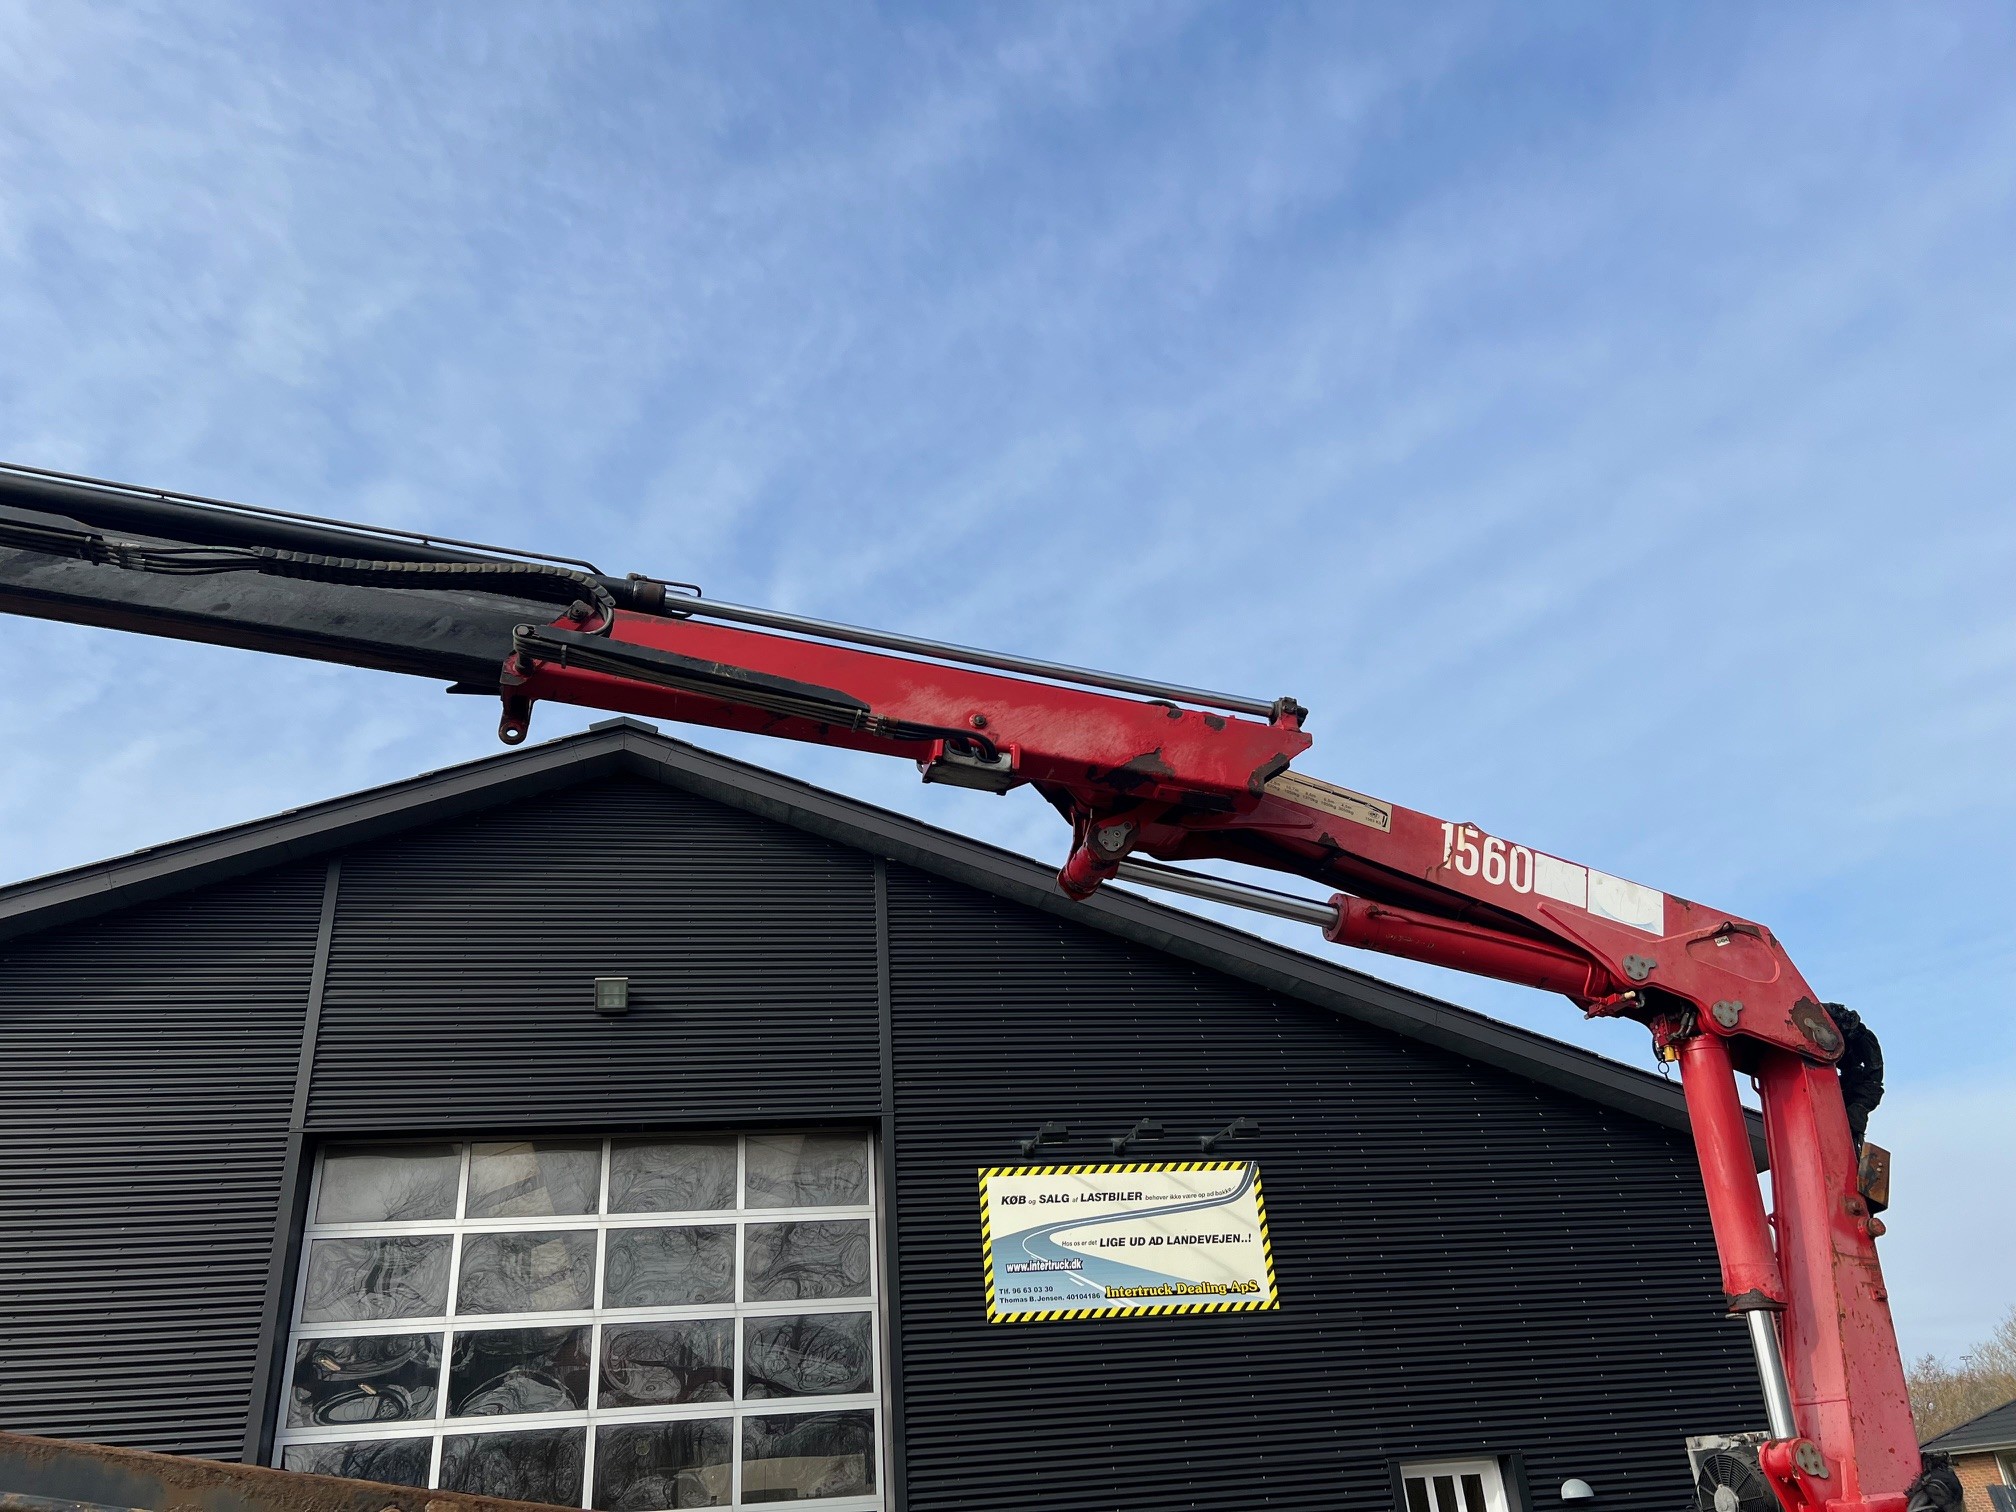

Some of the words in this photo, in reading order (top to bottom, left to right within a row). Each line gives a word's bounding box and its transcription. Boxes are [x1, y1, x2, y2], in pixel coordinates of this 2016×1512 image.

[1441, 822, 1533, 893] 1560
[1001, 1195, 1026, 1205] KØB
[1039, 1193, 1069, 1204] SALG
[1080, 1191, 1143, 1202] LASTBILER
[1100, 1237, 1126, 1247] LIGE
[1129, 1236, 1146, 1247] UD
[1148, 1236, 1164, 1246] AD
[1105, 1283, 1173, 1298] Intertruck
[1175, 1281, 1228, 1296] Dealing
[1230, 1279, 1260, 1295] ApS
[999, 1296, 1028, 1304] Thomas
[1066, 1292, 1101, 1300] 40104186
